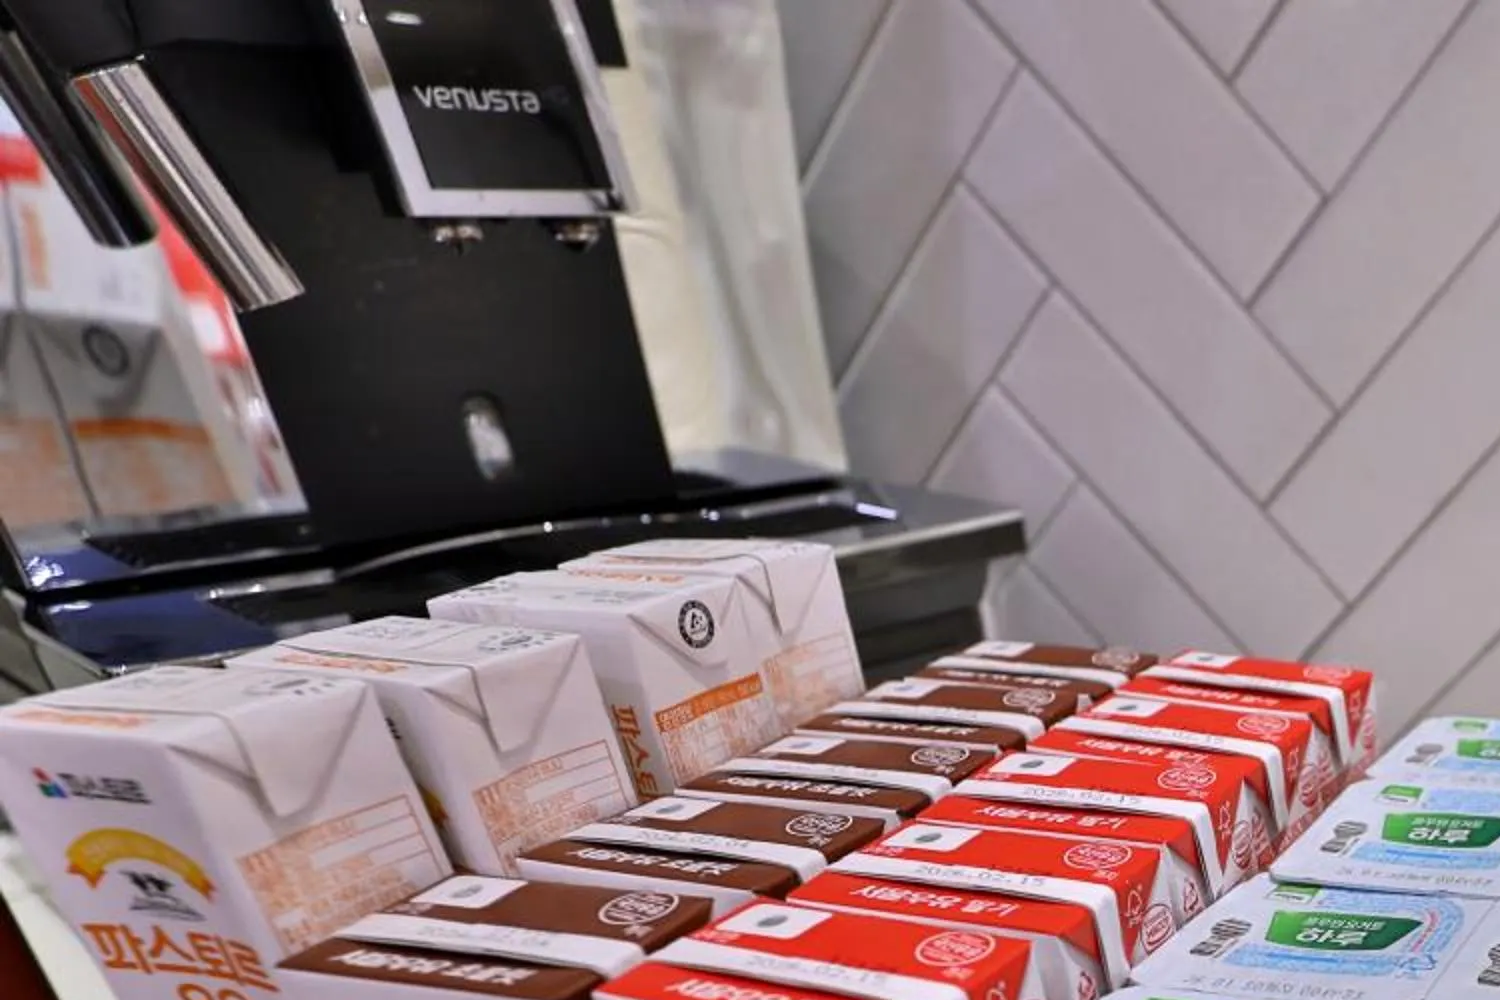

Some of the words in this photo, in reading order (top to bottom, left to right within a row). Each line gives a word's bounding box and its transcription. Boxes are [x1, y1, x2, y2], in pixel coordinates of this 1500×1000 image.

[1407, 826, 1472, 844] 하루
[849, 885, 963, 910] 서울우유
[959, 899, 1021, 917] 딸기
[1295, 927, 1368, 947] 하루
[81, 923, 281, 994] 파스퇴르
